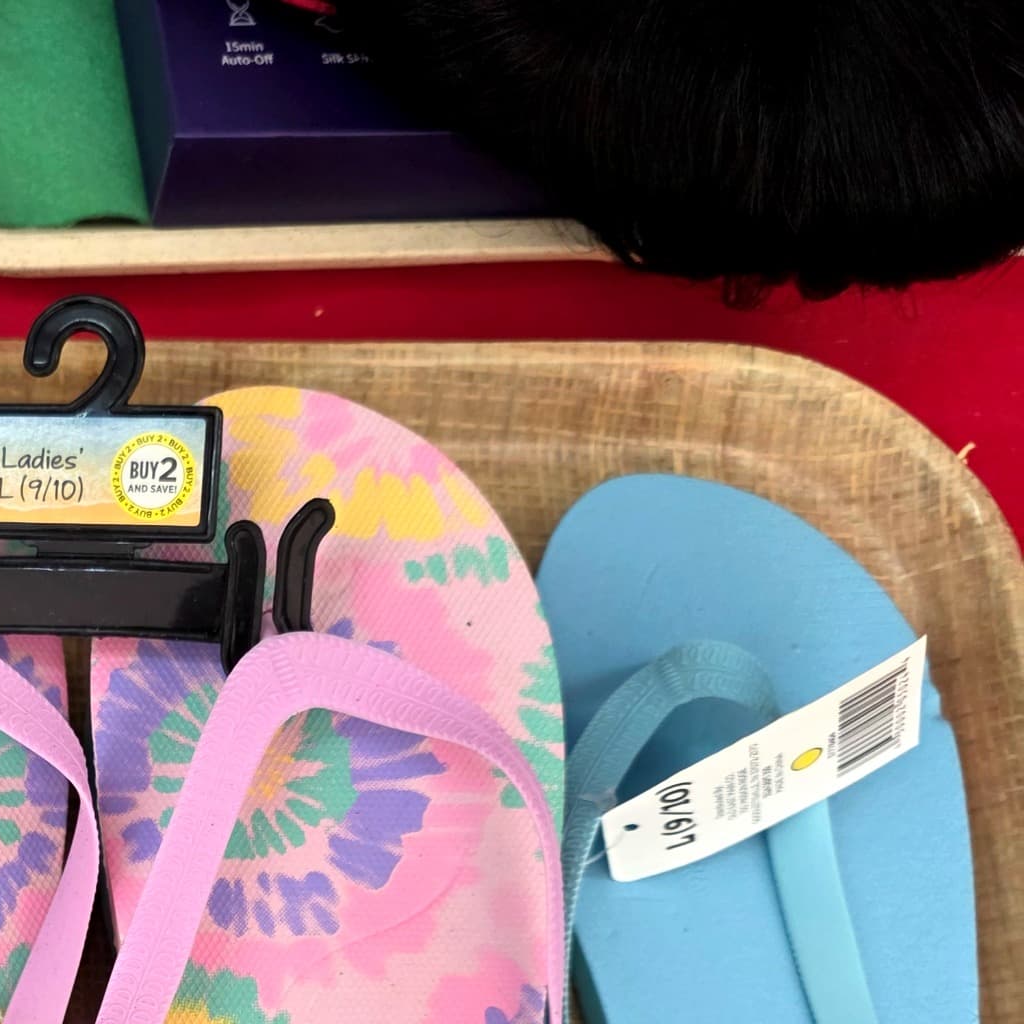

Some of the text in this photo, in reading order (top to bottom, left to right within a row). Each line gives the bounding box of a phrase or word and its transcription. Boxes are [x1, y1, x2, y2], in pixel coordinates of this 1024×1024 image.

[225, 41, 264, 53] 15min
[221, 53, 274, 66] Auto-Off
[136, 435, 155, 445] BUY
[169, 439, 185, 454] BUY
[2, 446, 84, 470] Ladies'
[114, 452, 126, 470] BUY
[130, 457, 178, 482] BUY 2
[186, 467, 194, 486] BUY
[0, 474, 84, 503] L (9/10)
[113, 484, 126, 503] BUY
[127, 484, 177, 493] AND SAVE!
[134, 509, 153, 518] BUY
[167, 498, 184, 515] BUY
